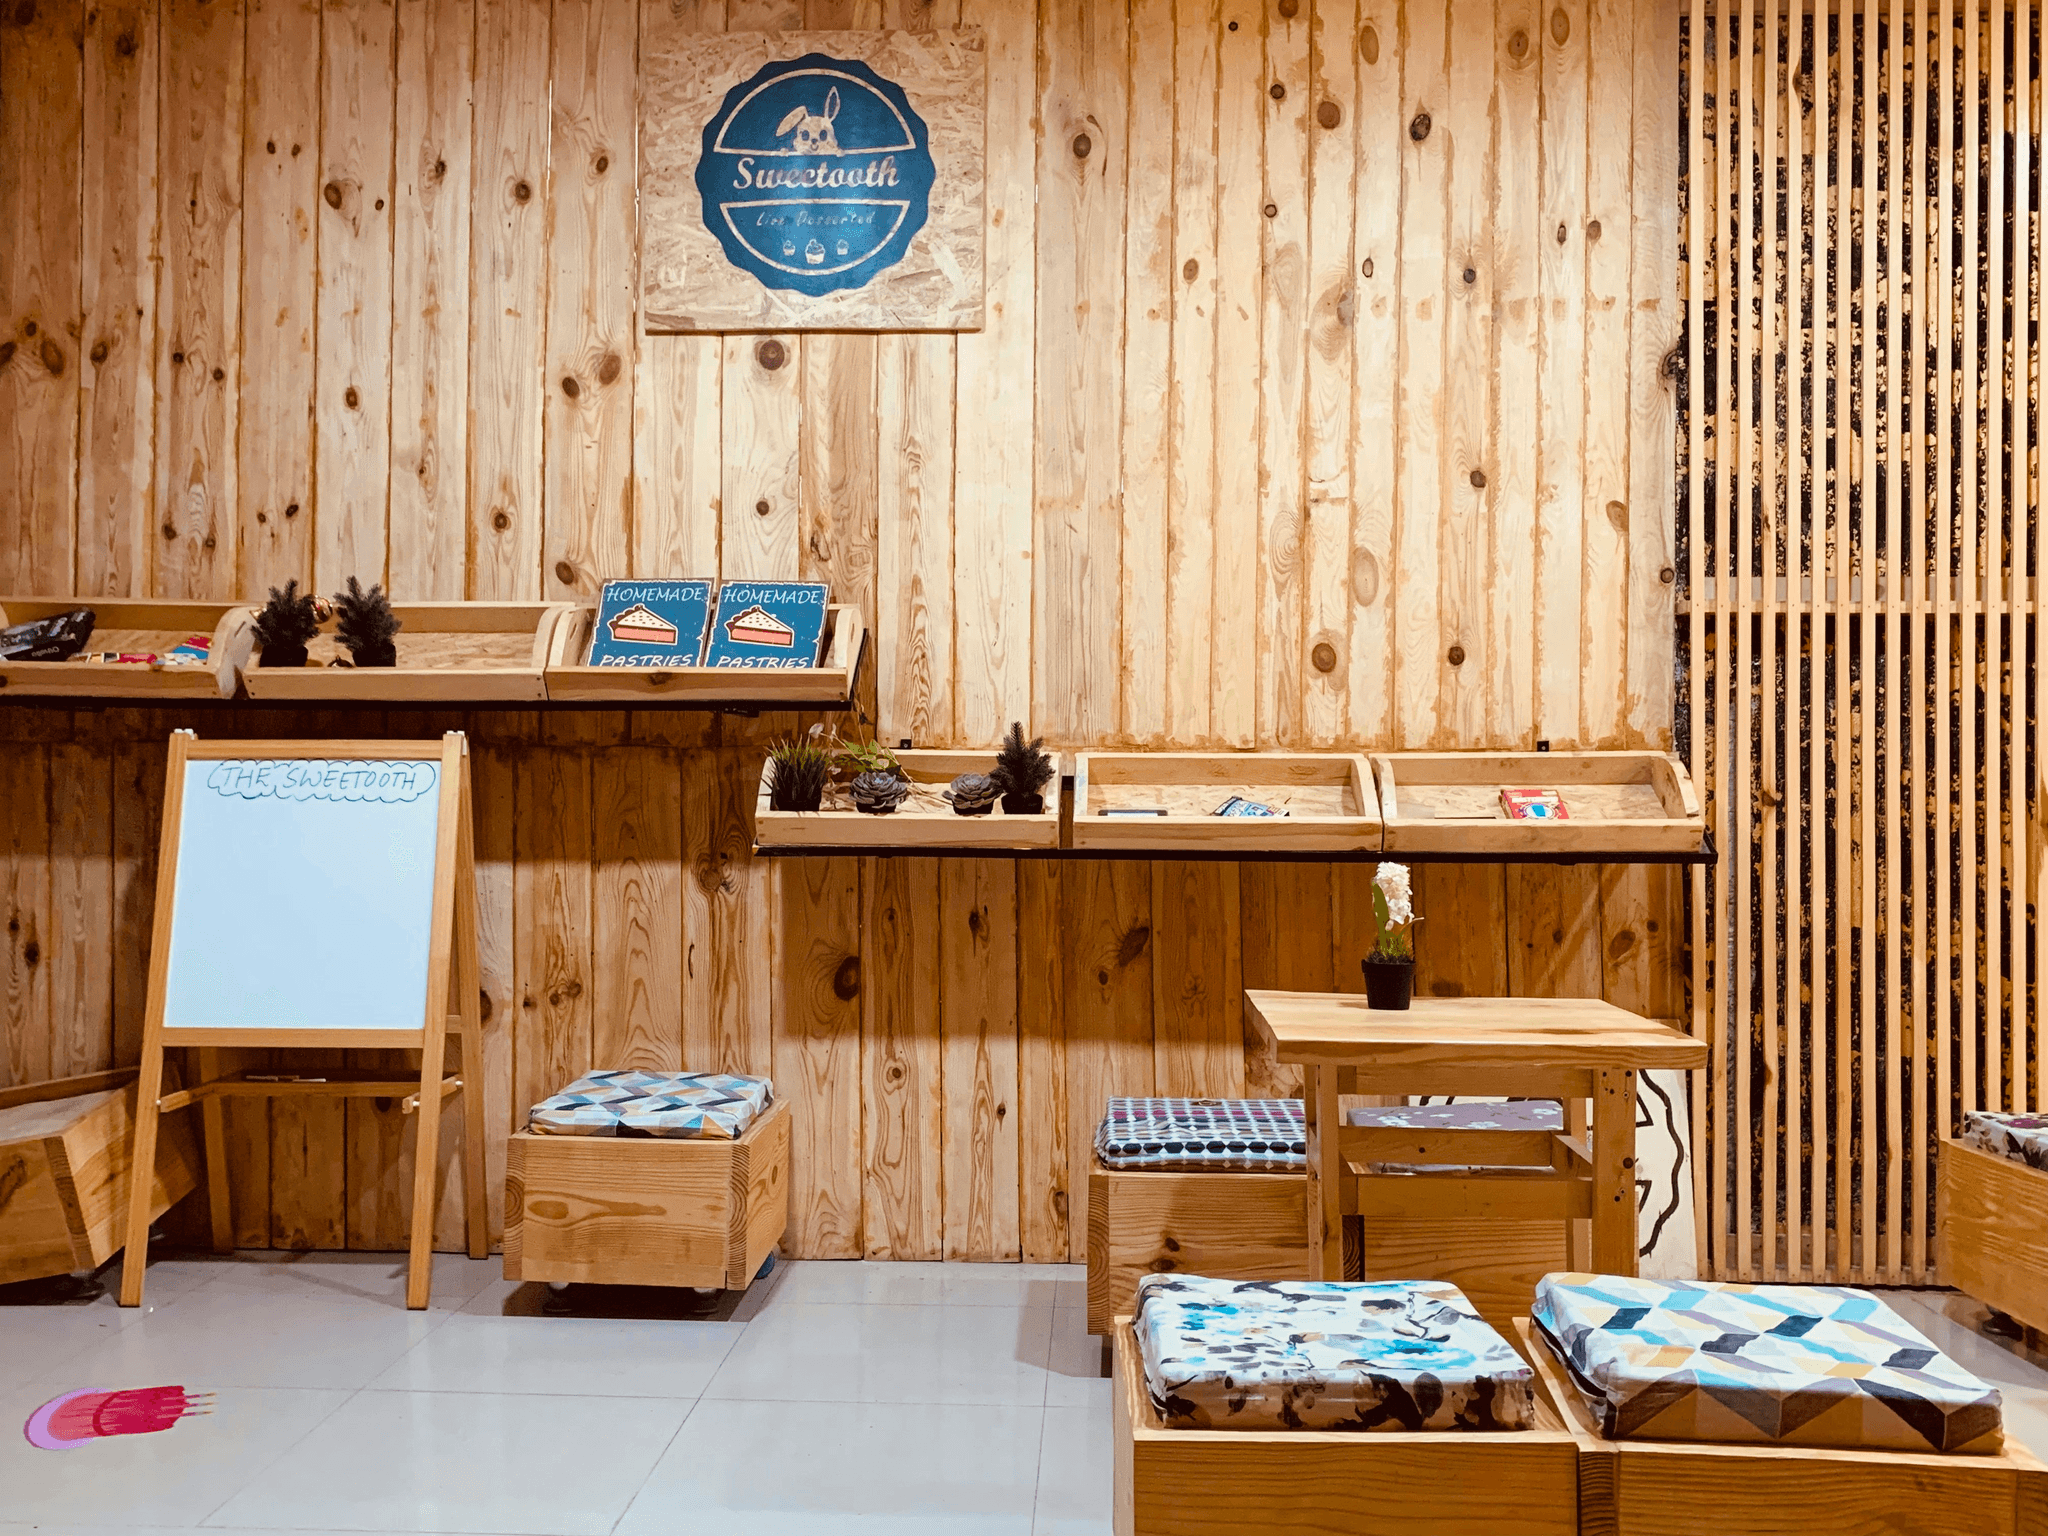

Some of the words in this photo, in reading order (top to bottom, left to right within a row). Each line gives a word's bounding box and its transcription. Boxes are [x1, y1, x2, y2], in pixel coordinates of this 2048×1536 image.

[733, 155, 900, 189] Sweetooth
[606, 586, 704, 602] HOMEMADE
[724, 588, 821, 605] HOMEMADE
[599, 654, 694, 667] PASTRIES
[716, 655, 810, 668] PASTRIES
[222, 766, 271, 789] THE
[283, 767, 417, 790] SWEETOOTH
